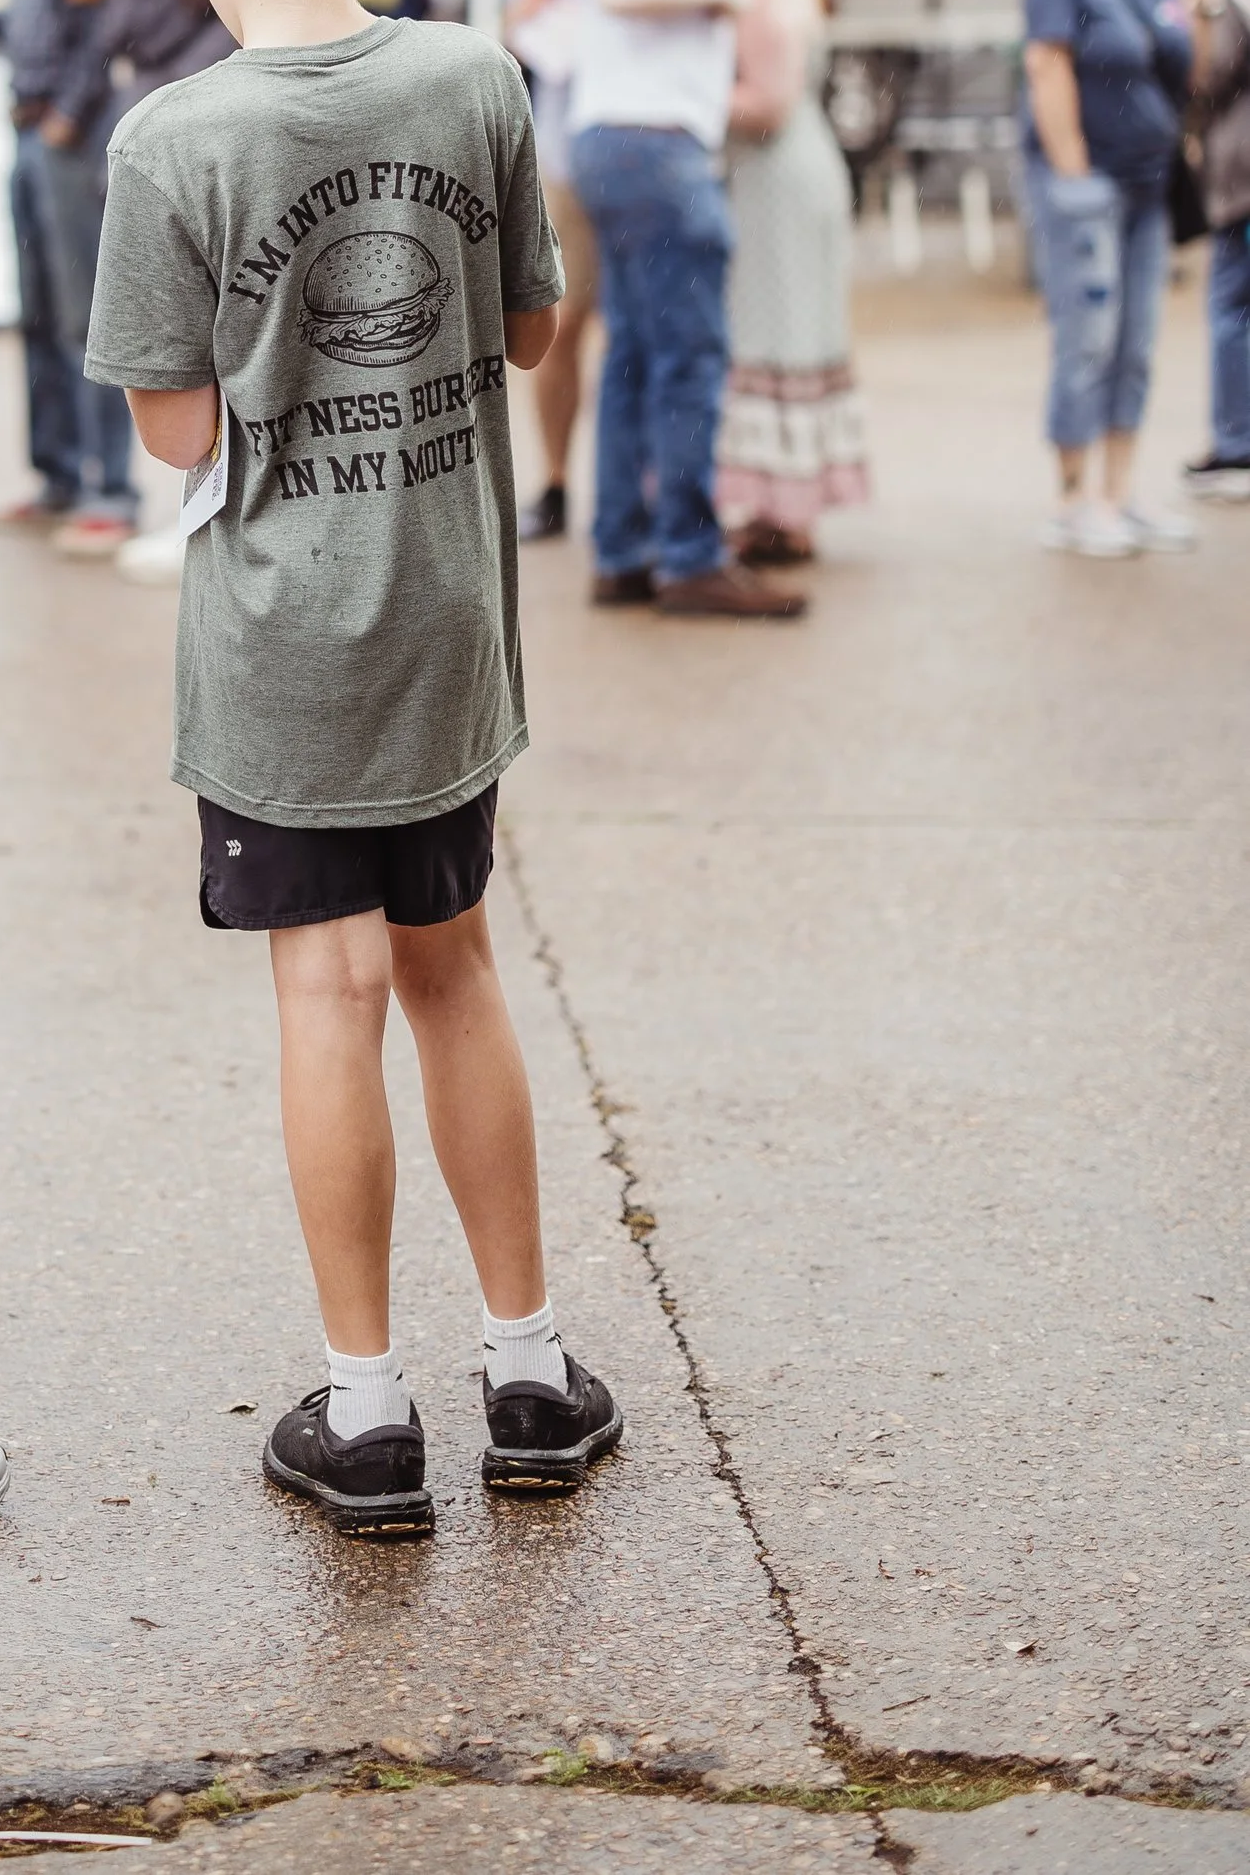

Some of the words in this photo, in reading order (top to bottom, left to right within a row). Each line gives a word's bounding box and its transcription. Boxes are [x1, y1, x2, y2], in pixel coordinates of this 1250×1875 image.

[227, 236, 291, 306] I'M
[276, 167, 360, 248] INTO
[367, 161, 497, 245] FITNESS
[274, 458, 320, 501] IN
[326, 451, 387, 495] MY
[397, 424, 480, 488] MOUT
